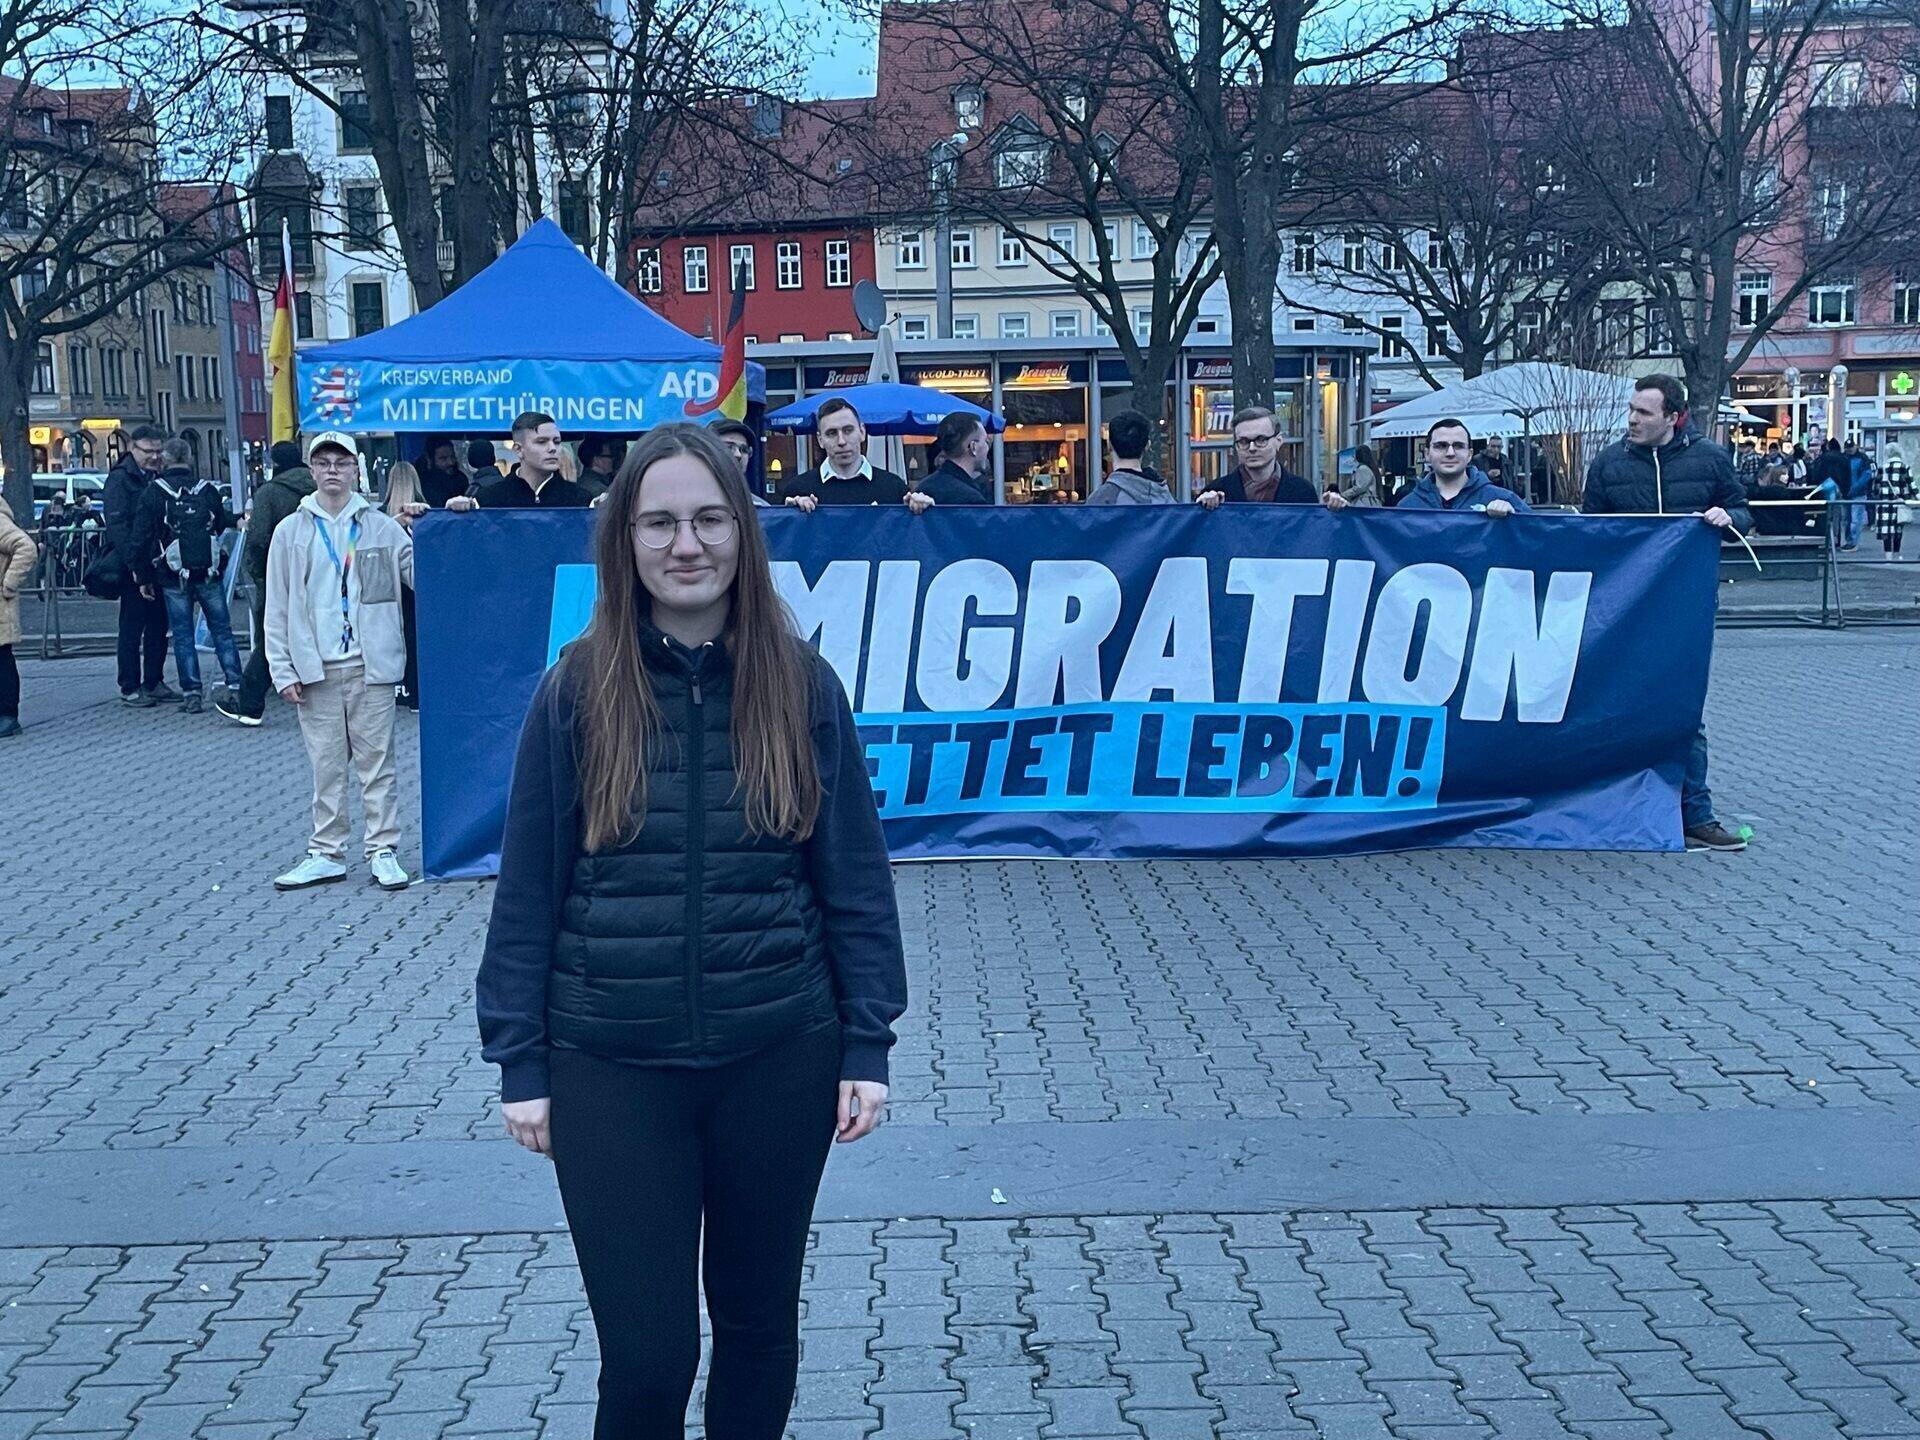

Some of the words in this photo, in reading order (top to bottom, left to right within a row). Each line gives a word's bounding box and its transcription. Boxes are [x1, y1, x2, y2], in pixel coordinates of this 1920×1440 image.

[380, 369, 513, 386] KREISVERBAND
[659, 369, 720, 399] AfD
[824, 369, 868, 386] Braugol
[1016, 365, 1069, 381] Braugold
[382, 392, 644, 421] MITTELTHÜRINGEN
[546, 556, 1592, 724] MIGRATION
[855, 713, 1112, 808] ETTET
[1132, 712, 1436, 799] LEBEN!
